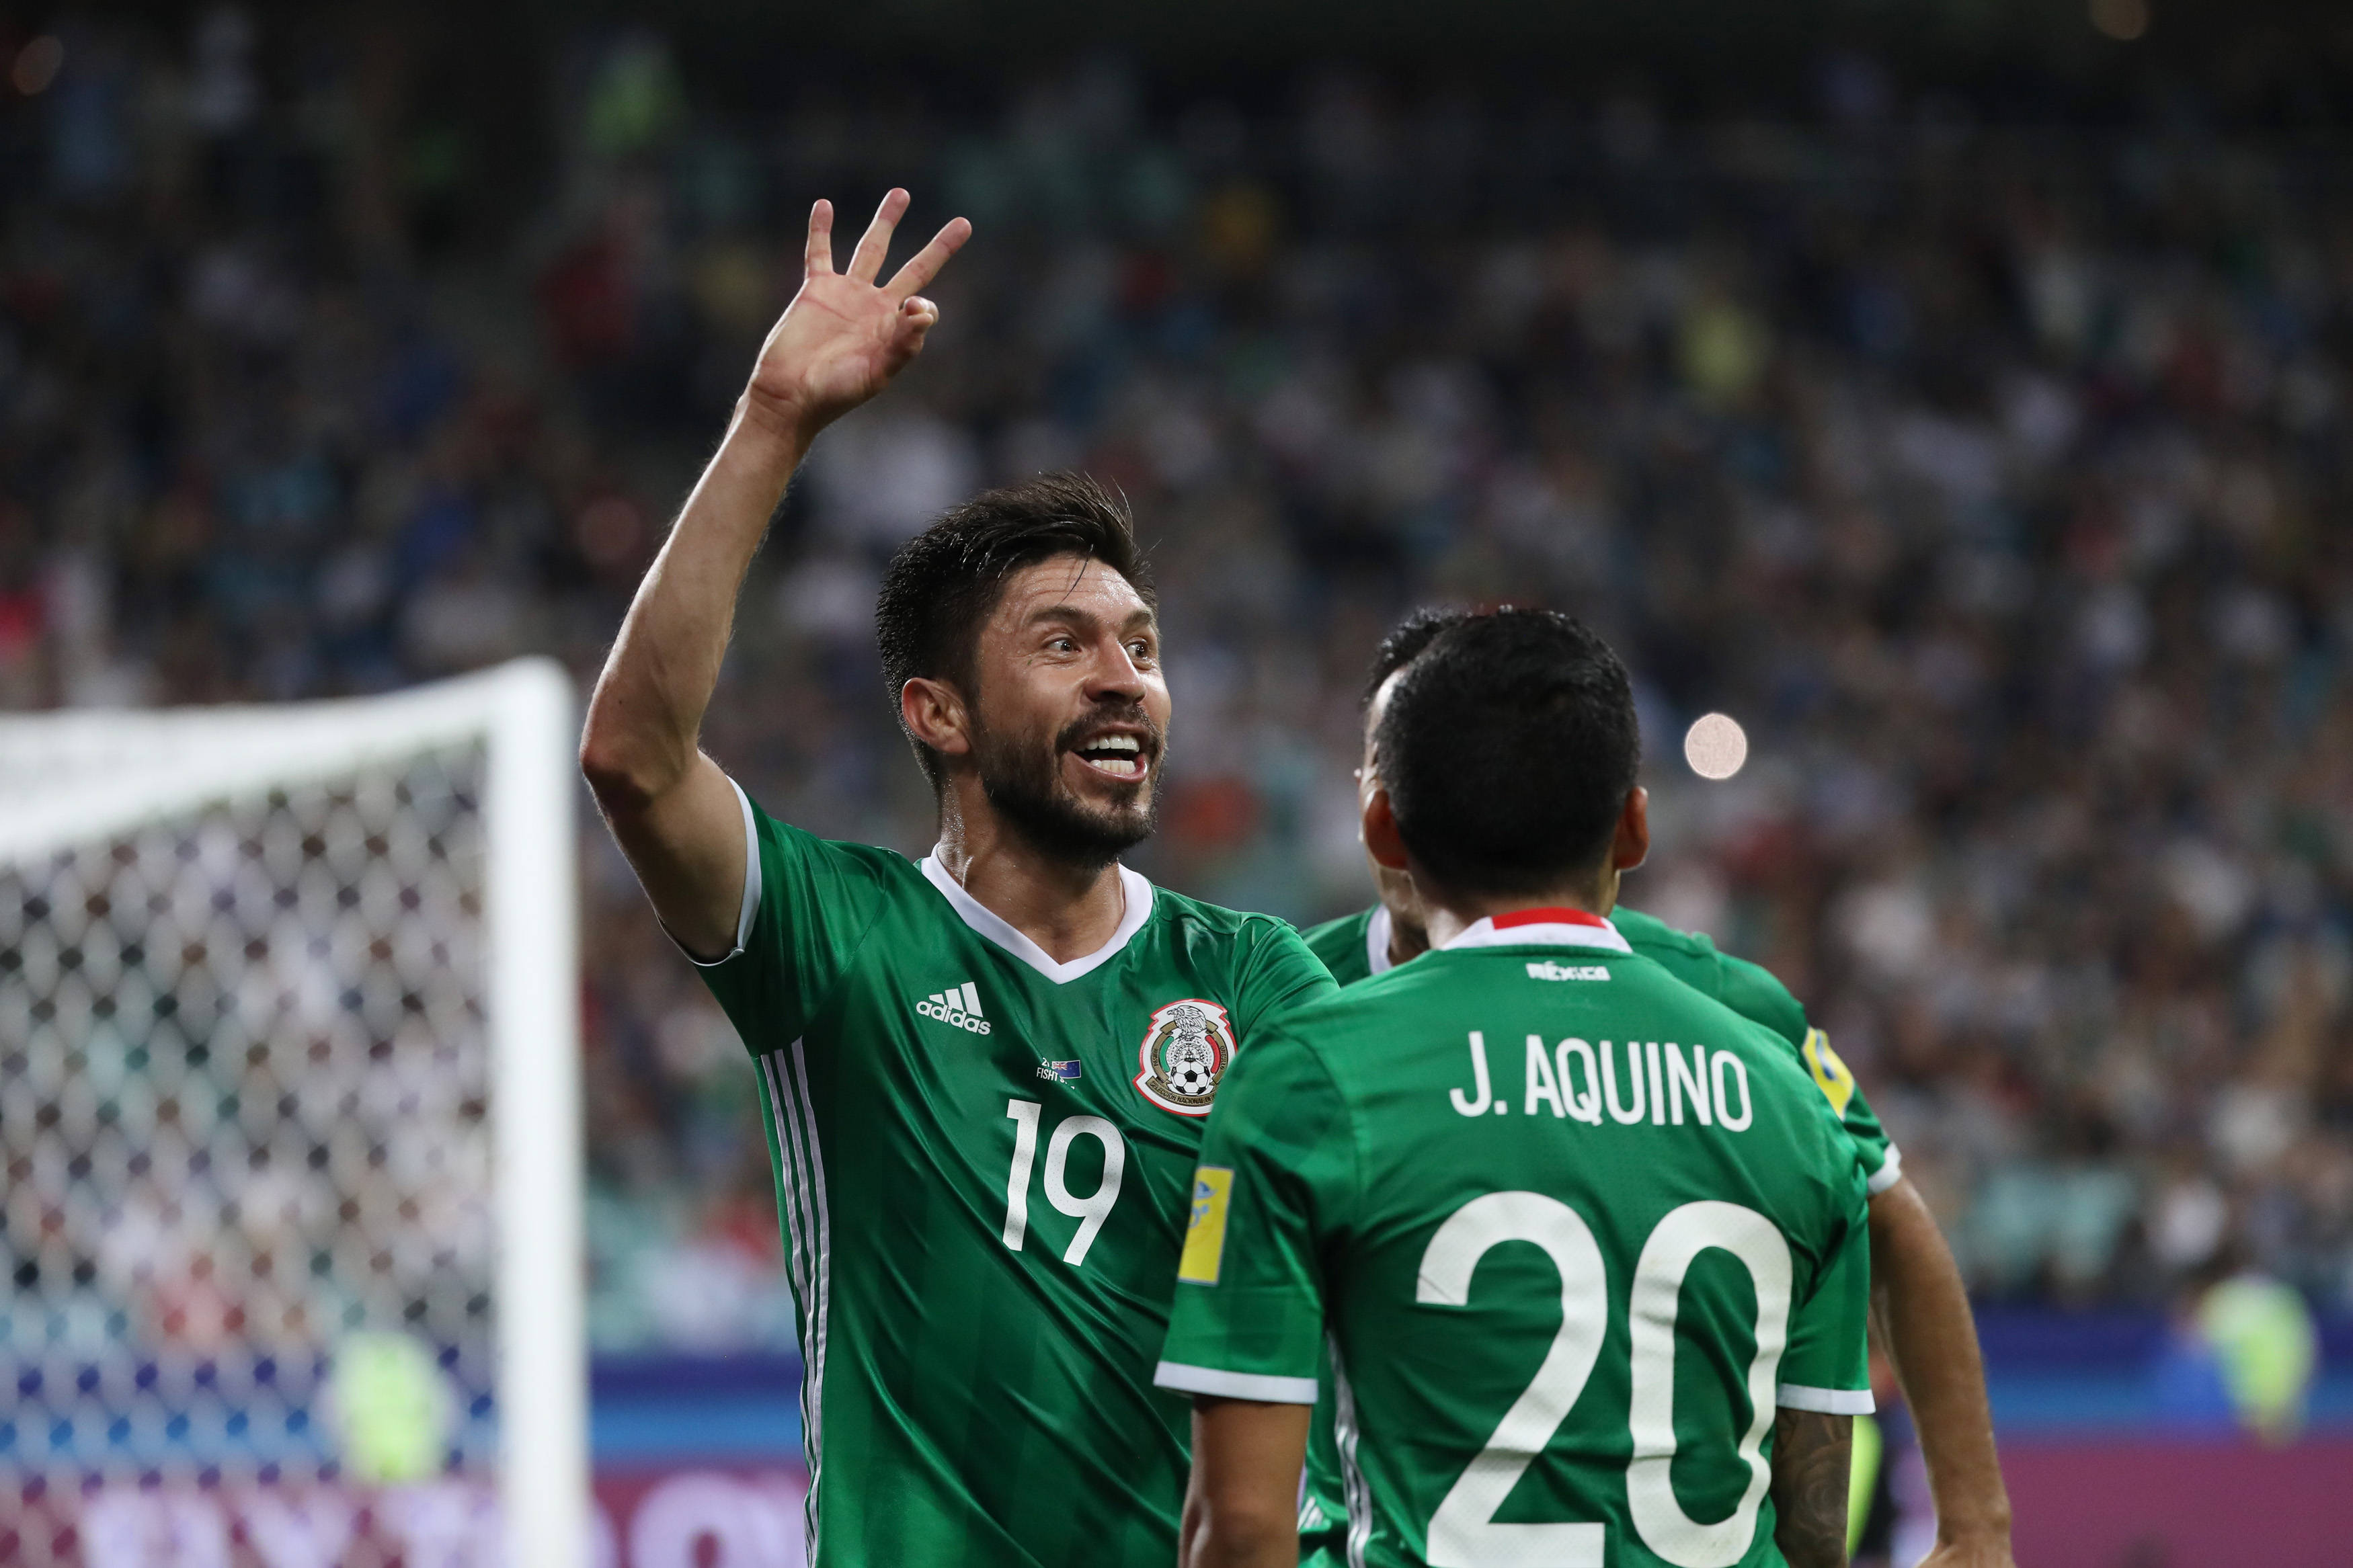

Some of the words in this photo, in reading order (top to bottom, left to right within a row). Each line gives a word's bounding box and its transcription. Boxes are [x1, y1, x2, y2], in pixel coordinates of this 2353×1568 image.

[916, 1000, 992, 1036] adidas
[1036, 1067, 1059, 1081] FISHT
[1449, 1030, 1507, 1117] J.
[1525, 1034, 1753, 1132] AQUINO
[1002, 1098, 1125, 1267] 19
[1416, 1190, 1802, 1568] 20
